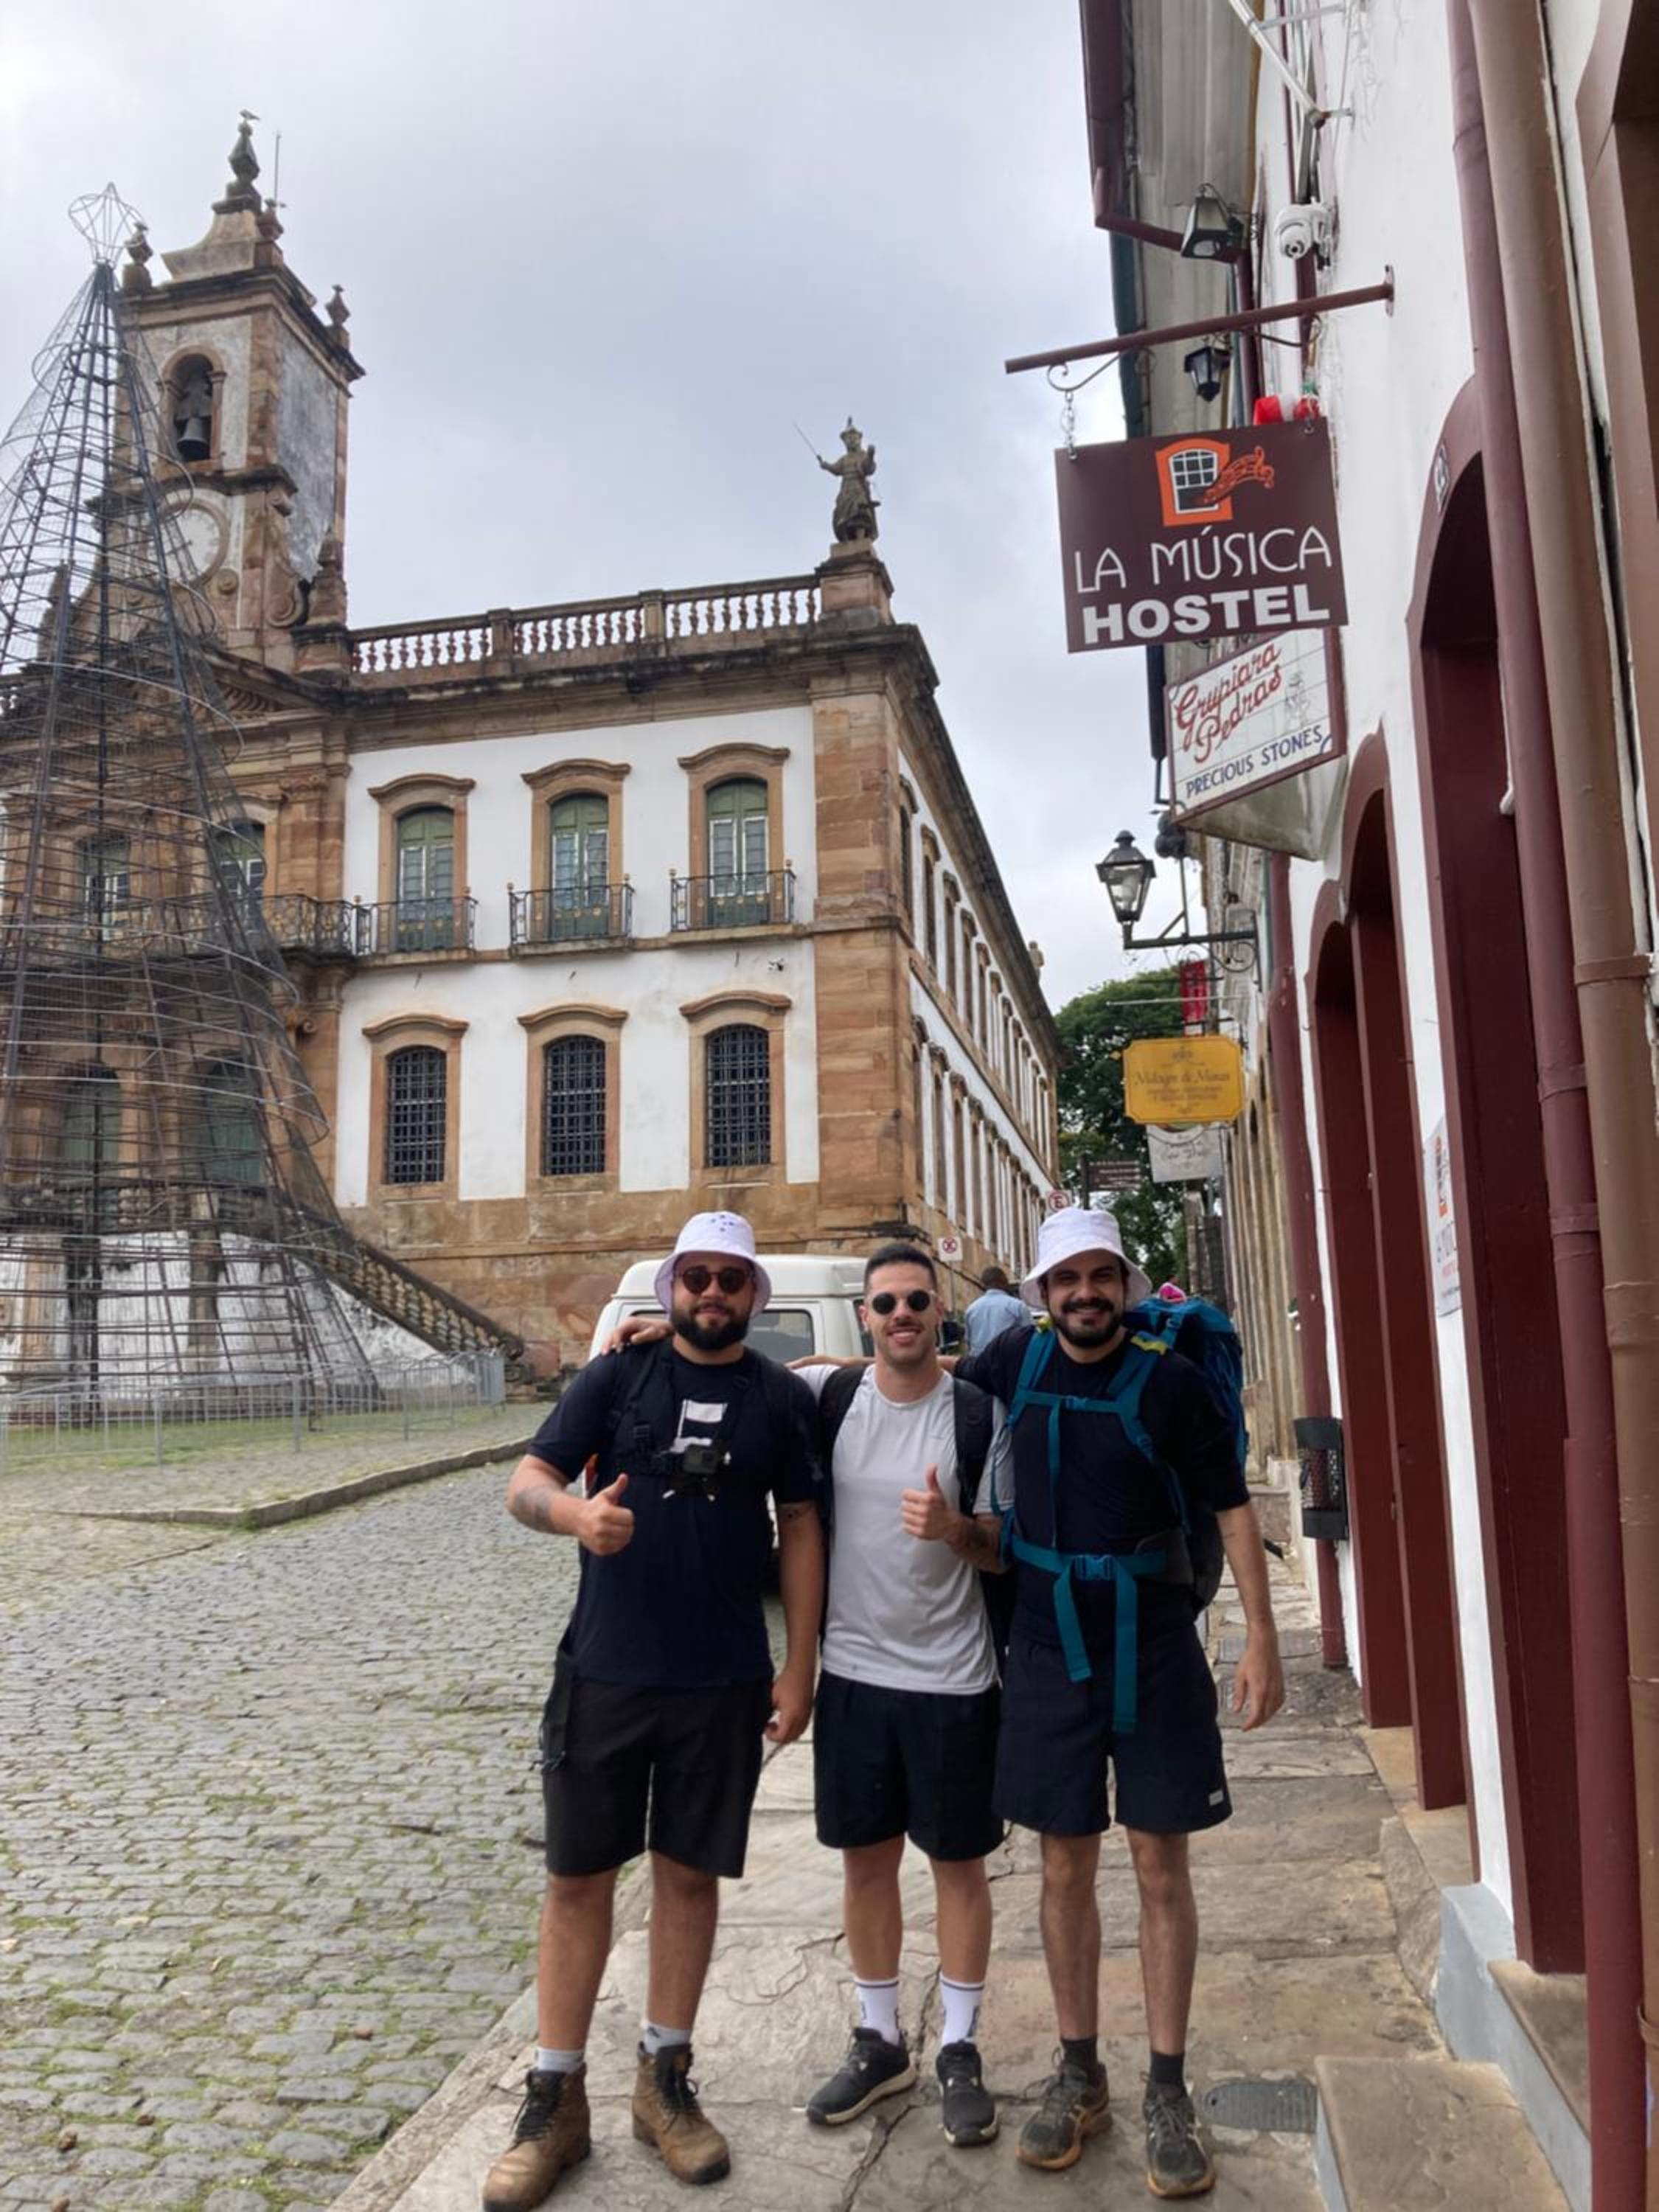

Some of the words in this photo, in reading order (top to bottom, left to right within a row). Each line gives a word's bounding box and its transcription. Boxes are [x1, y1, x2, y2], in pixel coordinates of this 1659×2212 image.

[1074, 548, 1126, 594] LA
[1150, 525, 1332, 585] MÚSICA
[1082, 584, 1330, 644] HOSTEL
[1175, 644, 1281, 751] Grupiara
[1194, 665, 1281, 763] Pedras
[1186, 754, 1253, 799] PRECIOUS
[1261, 725, 1324, 766] STONES
